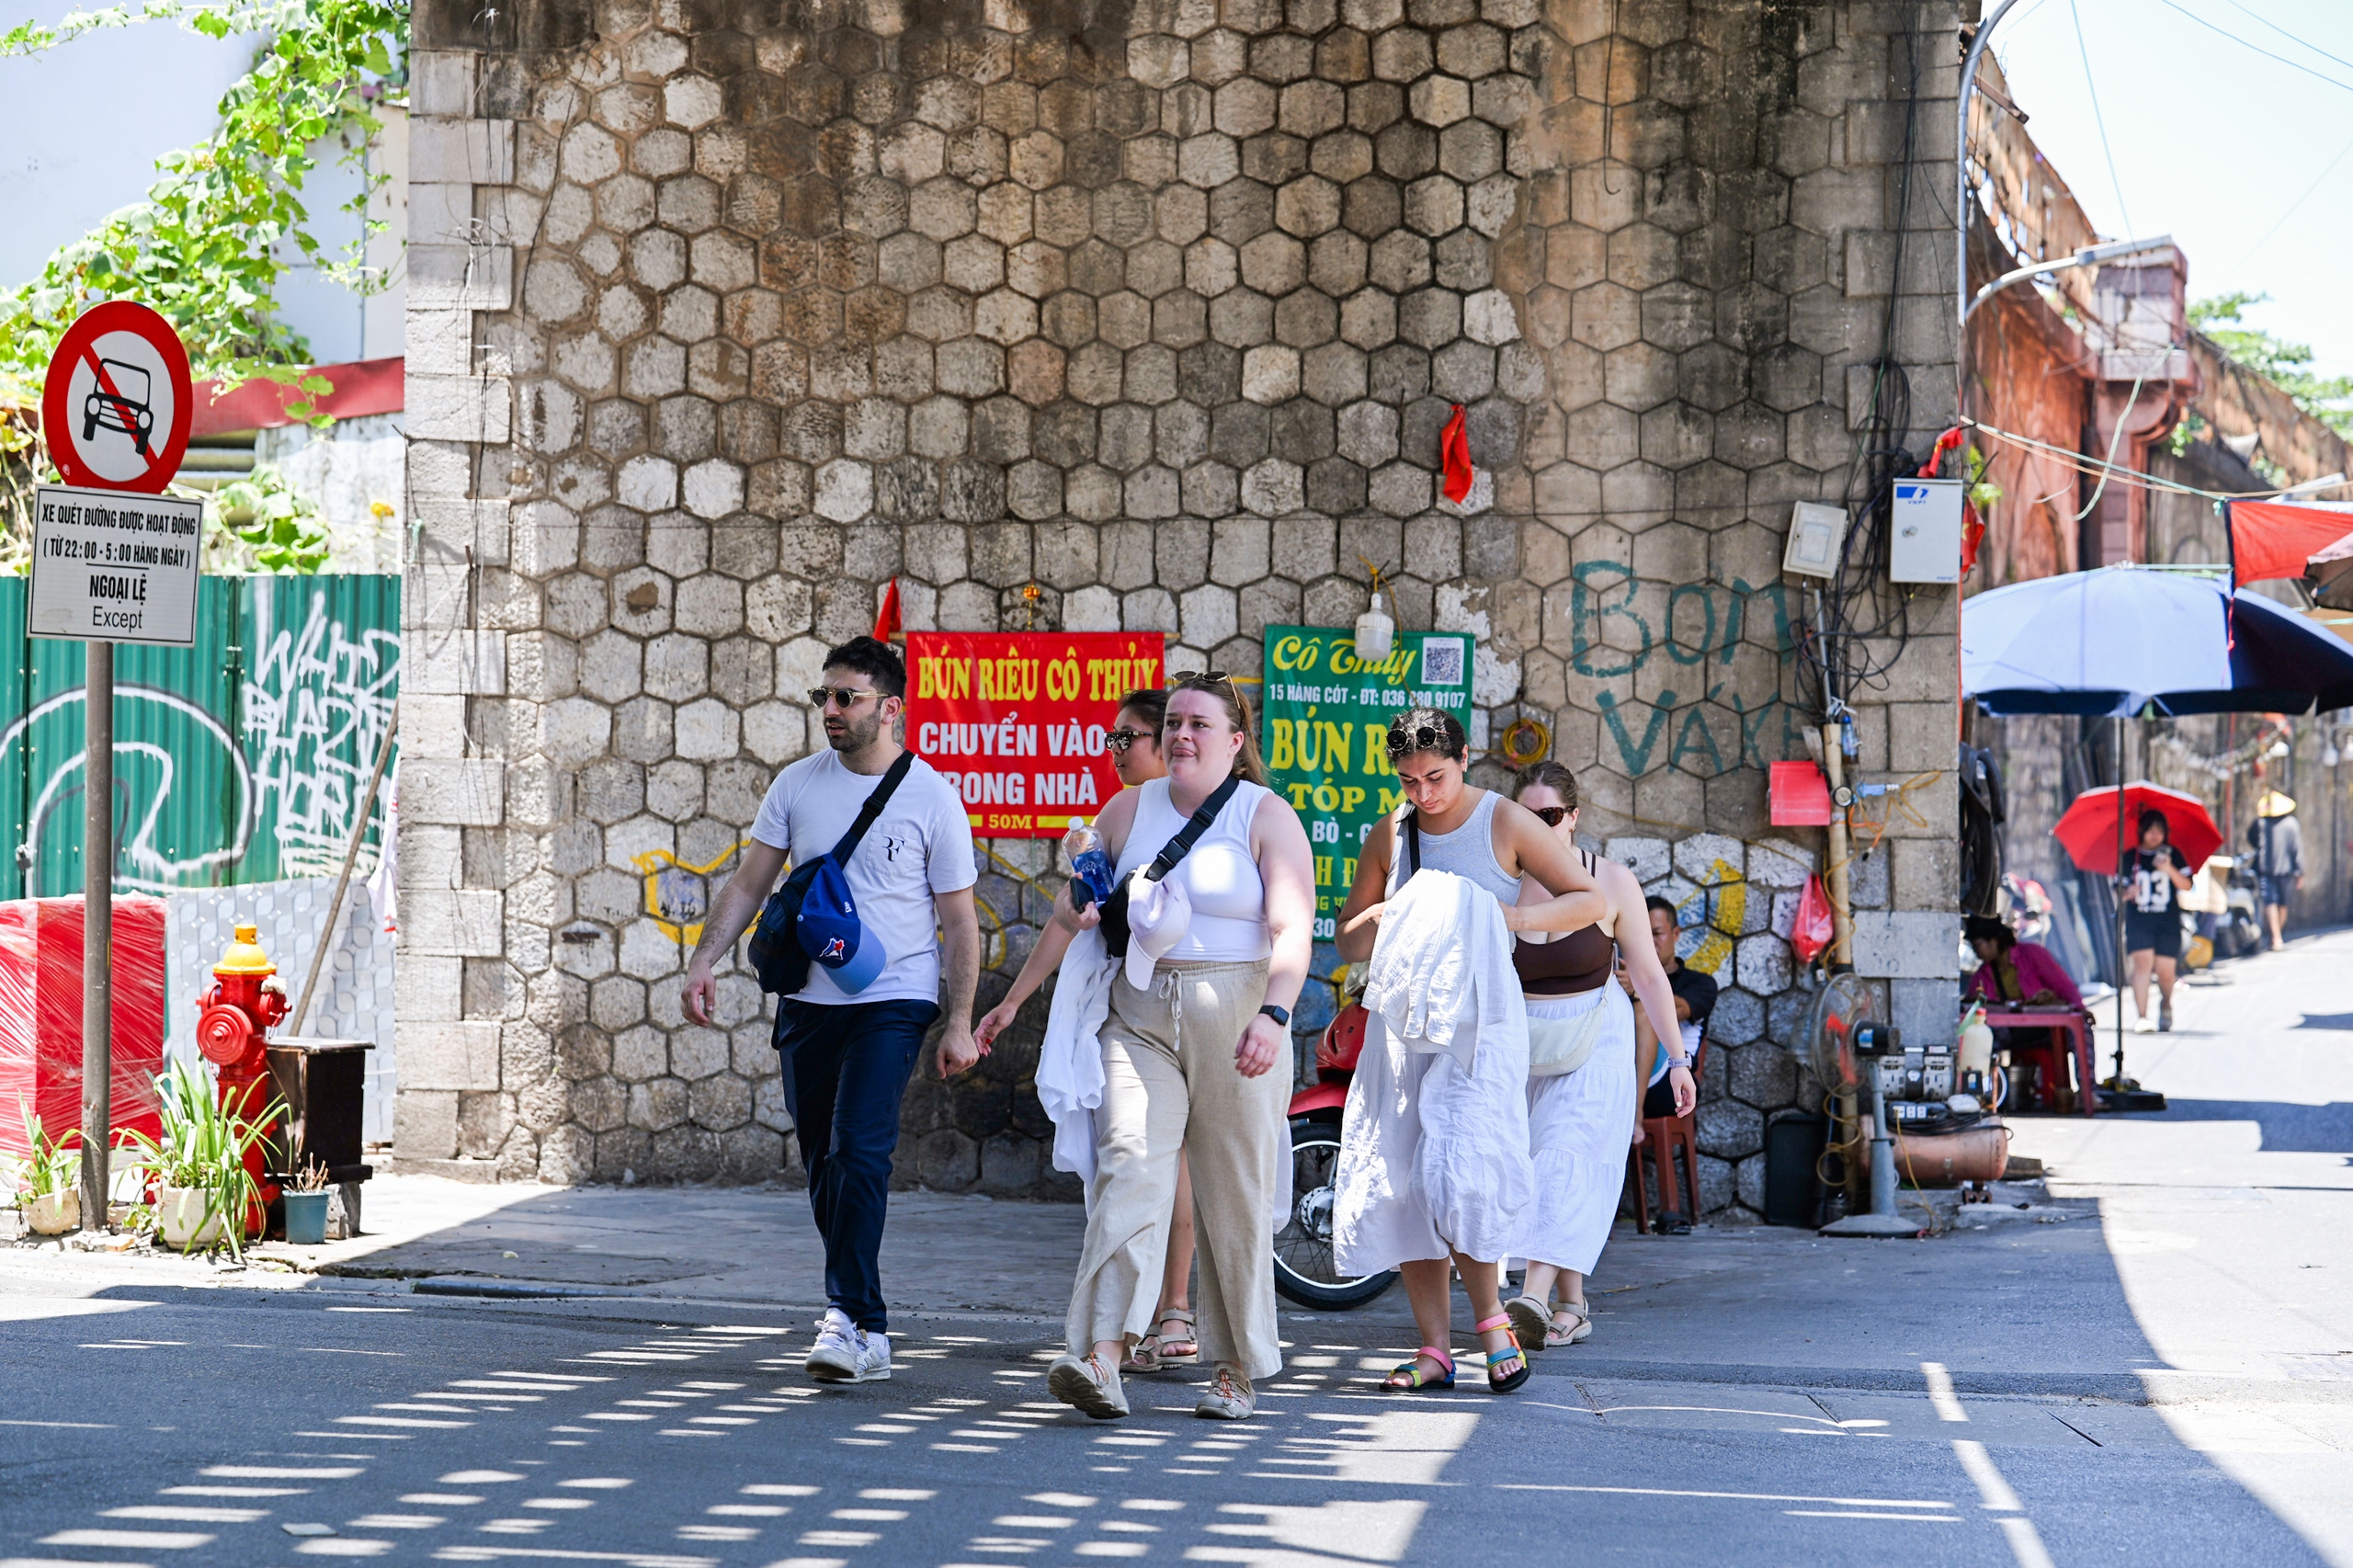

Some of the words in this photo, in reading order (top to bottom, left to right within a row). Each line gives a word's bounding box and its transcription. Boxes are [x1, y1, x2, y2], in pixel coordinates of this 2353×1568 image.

[41, 504, 55, 522] XE
[58, 502, 82, 525] QUÉT
[85, 505, 117, 528] ĐƯỜNG
[119, 511, 144, 534] ĐƯỢC
[146, 514, 170, 536] HOẠT
[171, 513, 196, 539] ĐỘNG
[133, 540, 158, 564] HÀNG
[89, 574, 129, 604] NGOẠI
[132, 574, 147, 606] LỆ
[93, 606, 142, 633] Except
[1272, 635, 1322, 672] Cô
[917, 645, 972, 699] BÚN
[978, 645, 1040, 701] RIÊU
[1046, 645, 1081, 701] CÔ
[1086, 641, 1158, 701] THỦY
[1269, 684, 1284, 700] 15
[1287, 681, 1321, 703] HÀNG
[1324, 683, 1348, 704] CÓT
[1359, 687, 1379, 706] ĐT:
[1381, 689, 1405, 706] 036
[1435, 691, 1466, 709] 9107
[919, 711, 1037, 756] CHUYỂN
[1046, 718, 1105, 756] VÀO
[1269, 705, 1353, 774] BÚN
[1362, 722, 1398, 777] R
[937, 771, 1025, 805] RONG
[1034, 767, 1098, 805] NHÀ
[1288, 778, 1366, 812] TÓP
[1377, 787, 1408, 814] M
[988, 814, 1032, 829] 50M
[1312, 816, 1339, 844] BÒ
[1315, 856, 1334, 886] H
